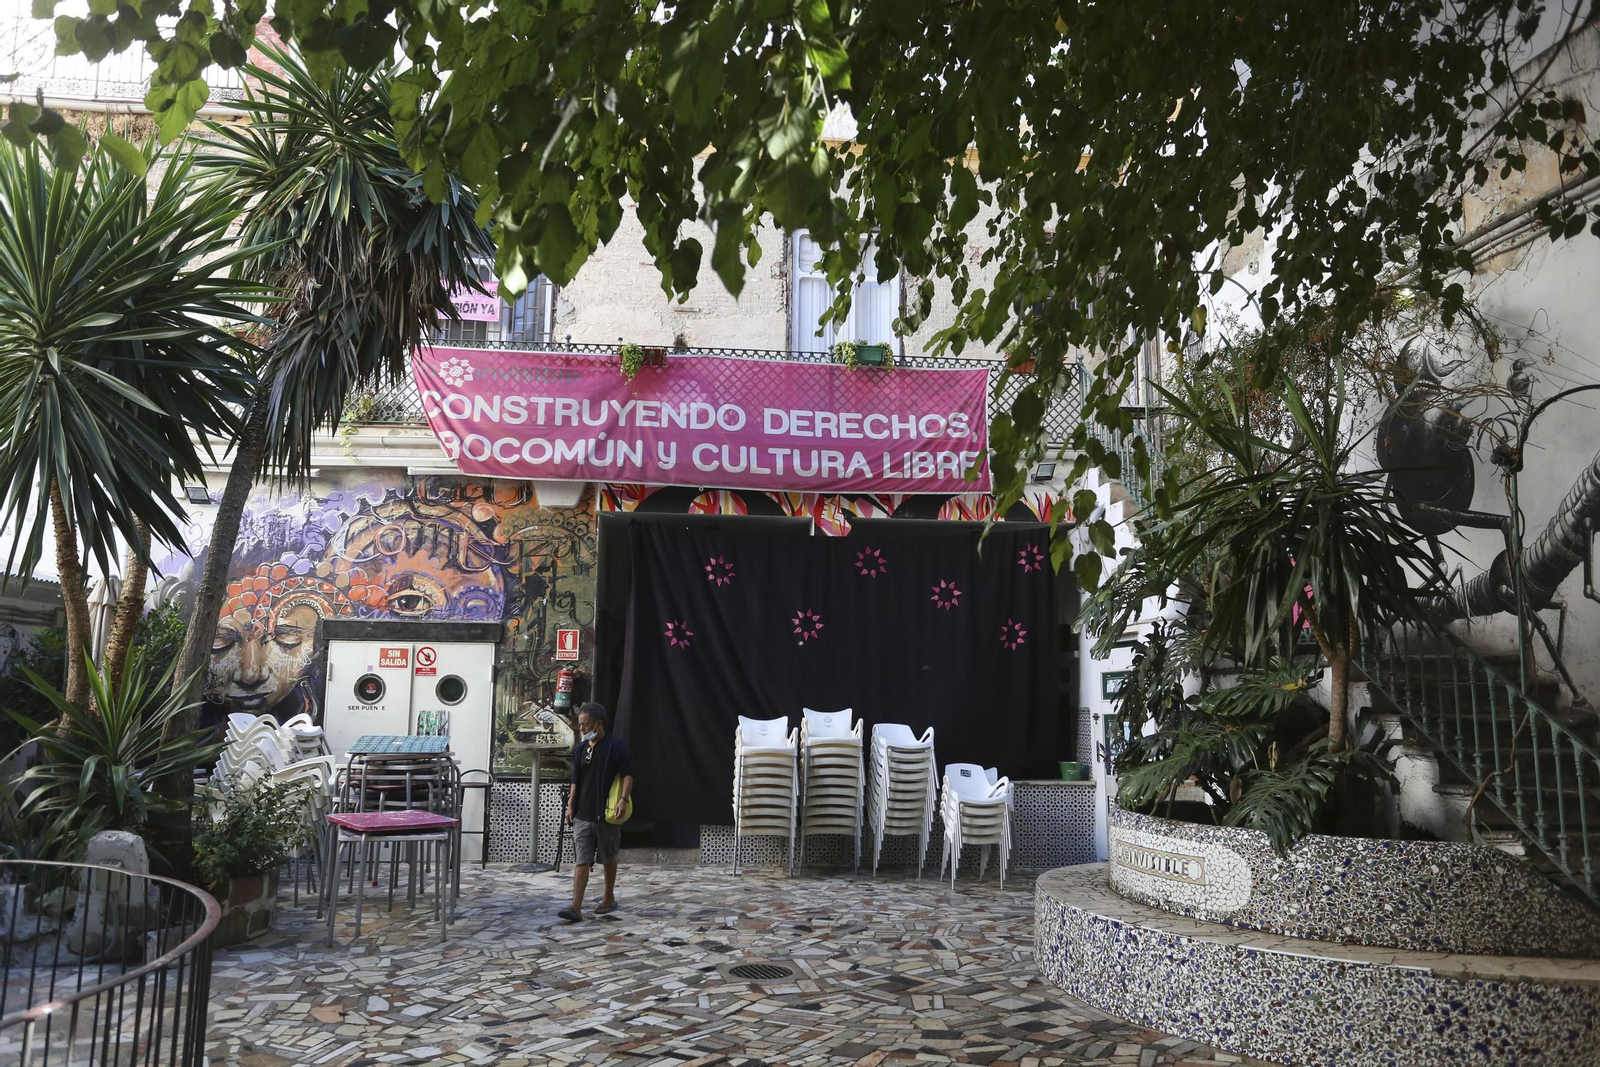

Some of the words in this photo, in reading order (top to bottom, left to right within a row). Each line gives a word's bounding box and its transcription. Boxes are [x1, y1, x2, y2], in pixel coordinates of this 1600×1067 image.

[462, 287, 497, 297] invisle
[481, 303, 495, 315] YA
[475, 363, 580, 384] invisible
[422, 390, 747, 432] CONSTRUYENDO
[763, 407, 978, 443] DERECHOS,
[692, 442, 873, 479] CULTURA
[387, 649, 401, 657] SIN
[380, 658, 407, 666] SALIDA
[1129, 849, 1189, 876] INVISIBLE
